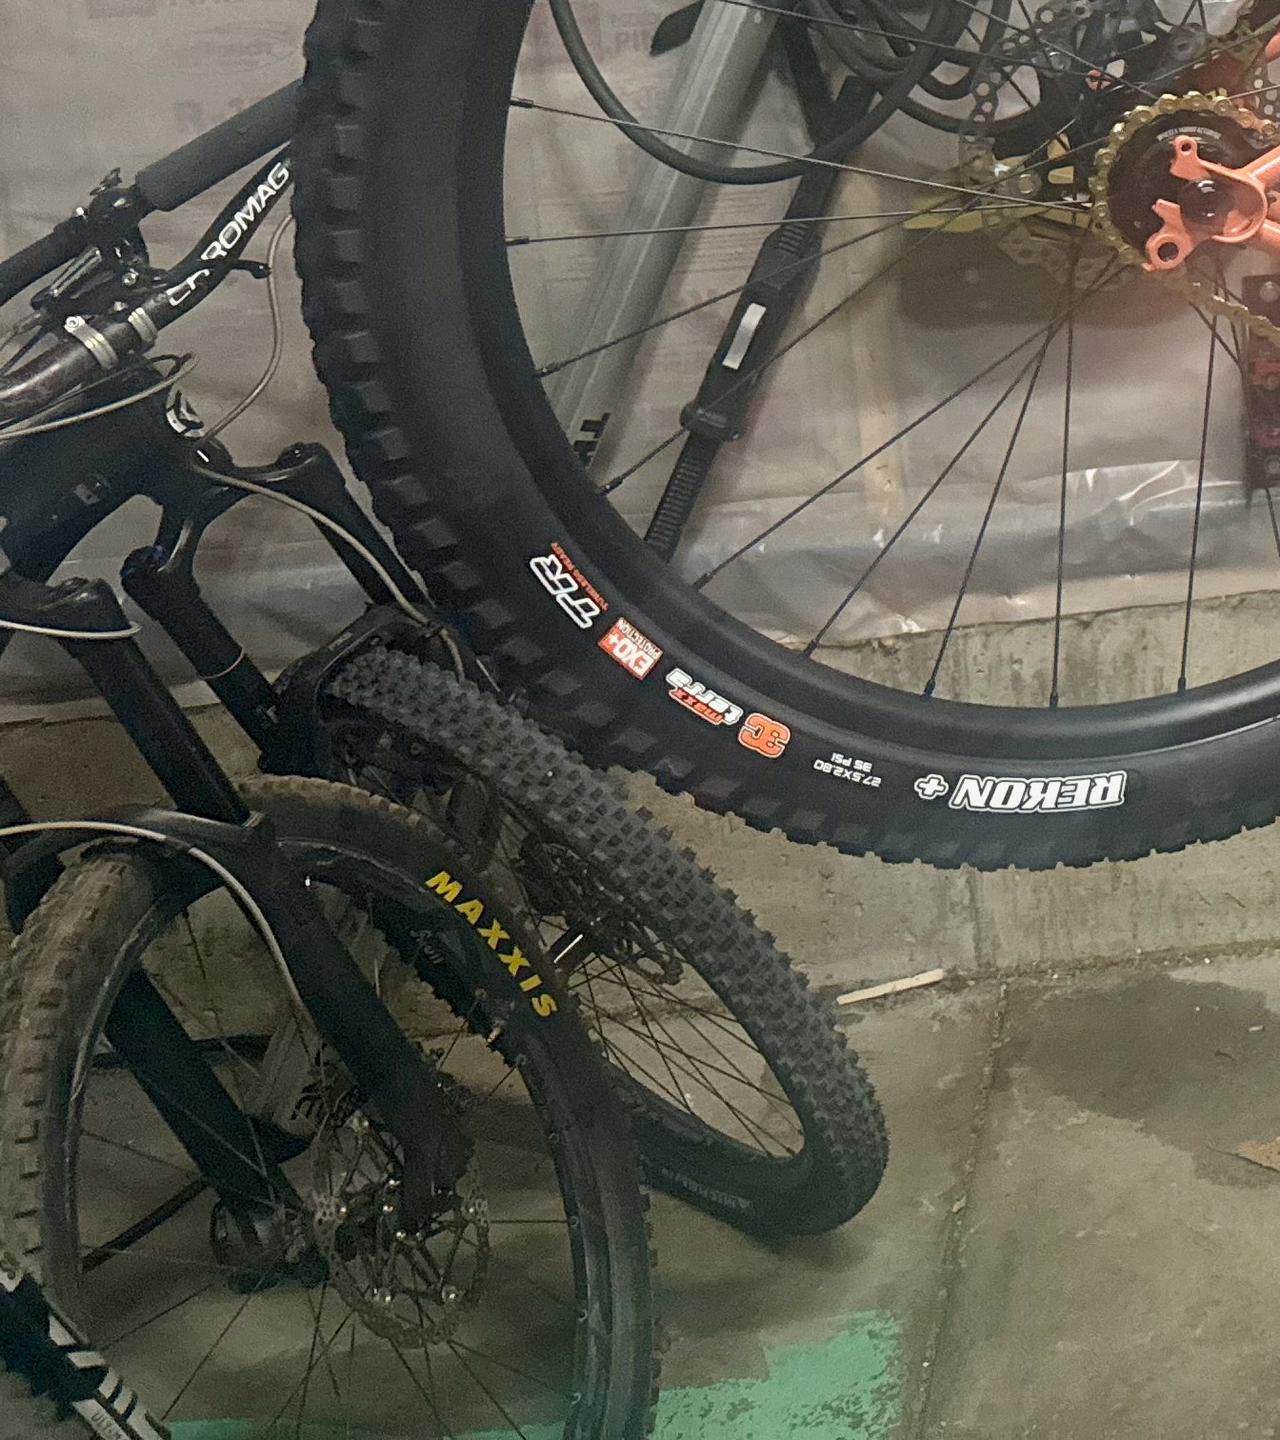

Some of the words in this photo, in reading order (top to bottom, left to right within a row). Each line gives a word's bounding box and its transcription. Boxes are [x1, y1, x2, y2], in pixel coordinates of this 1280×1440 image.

[529, 553, 601, 630] TR
[616, 616, 664, 660] PROTECTION
[665, 667, 744, 725] terra
[738, 712, 791, 759] 3C
[813, 759, 882, 788] 27.5X2.80
[830, 752, 853, 767] PSI
[853, 760, 873, 773] 35
[949, 769, 1128, 814] REKON
[424, 870, 560, 1019] MAXXIS
